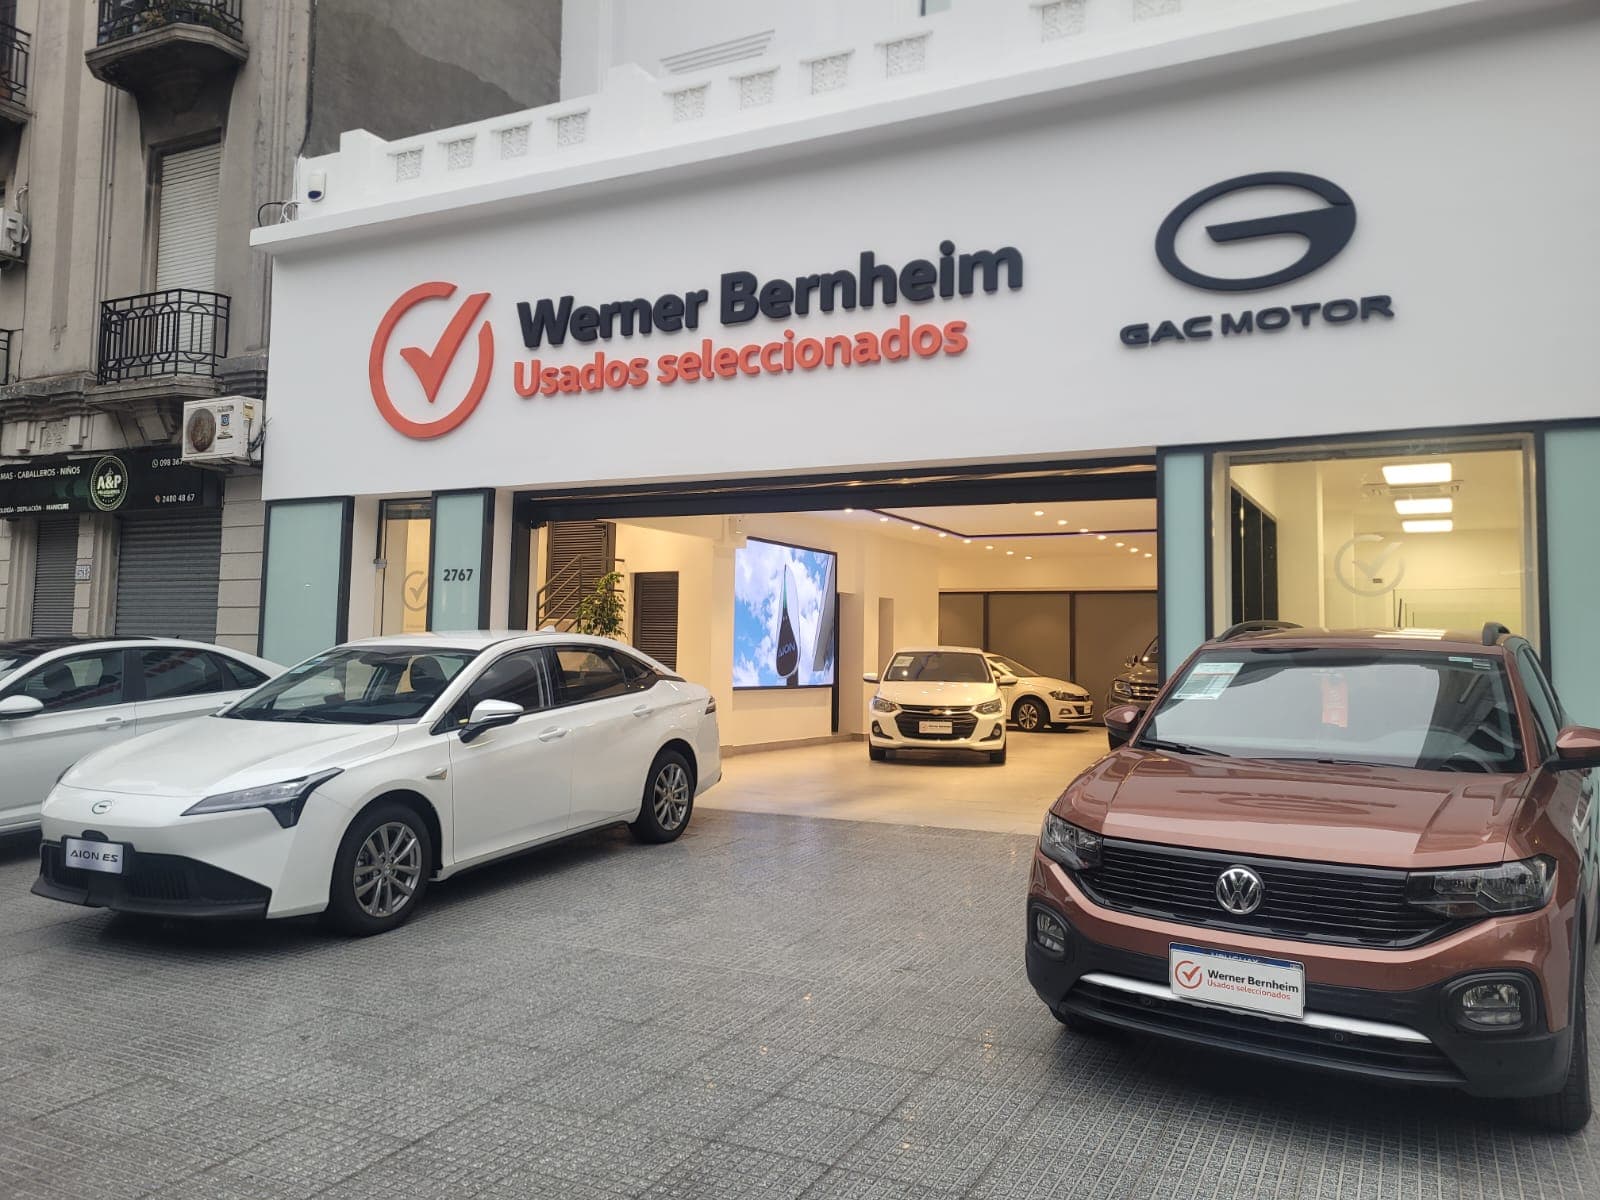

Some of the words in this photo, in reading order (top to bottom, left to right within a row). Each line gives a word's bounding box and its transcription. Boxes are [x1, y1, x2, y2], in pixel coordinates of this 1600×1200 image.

[516, 295, 709, 349] Werner
[720, 239, 1023, 326] Bernheim
[1119, 315, 1212, 346] GAC
[1221, 294, 1395, 336] MOTOR
[514, 351, 649, 398] Usados
[657, 314, 968, 385] seleccionados
[17, 468, 56, 479] CABALLEROS
[60, 465, 81, 475] NIÑOS
[97, 474, 122, 490] A&P
[443, 568, 474, 582] 2767
[70, 849, 100, 861] AION
[102, 853, 119, 863] ES
[1207, 969, 1246, 984] Werner
[1247, 976, 1300, 993] Bernheim
[1207, 979, 1236, 991] Usados
[1236, 984, 1292, 1001] seleccionados
